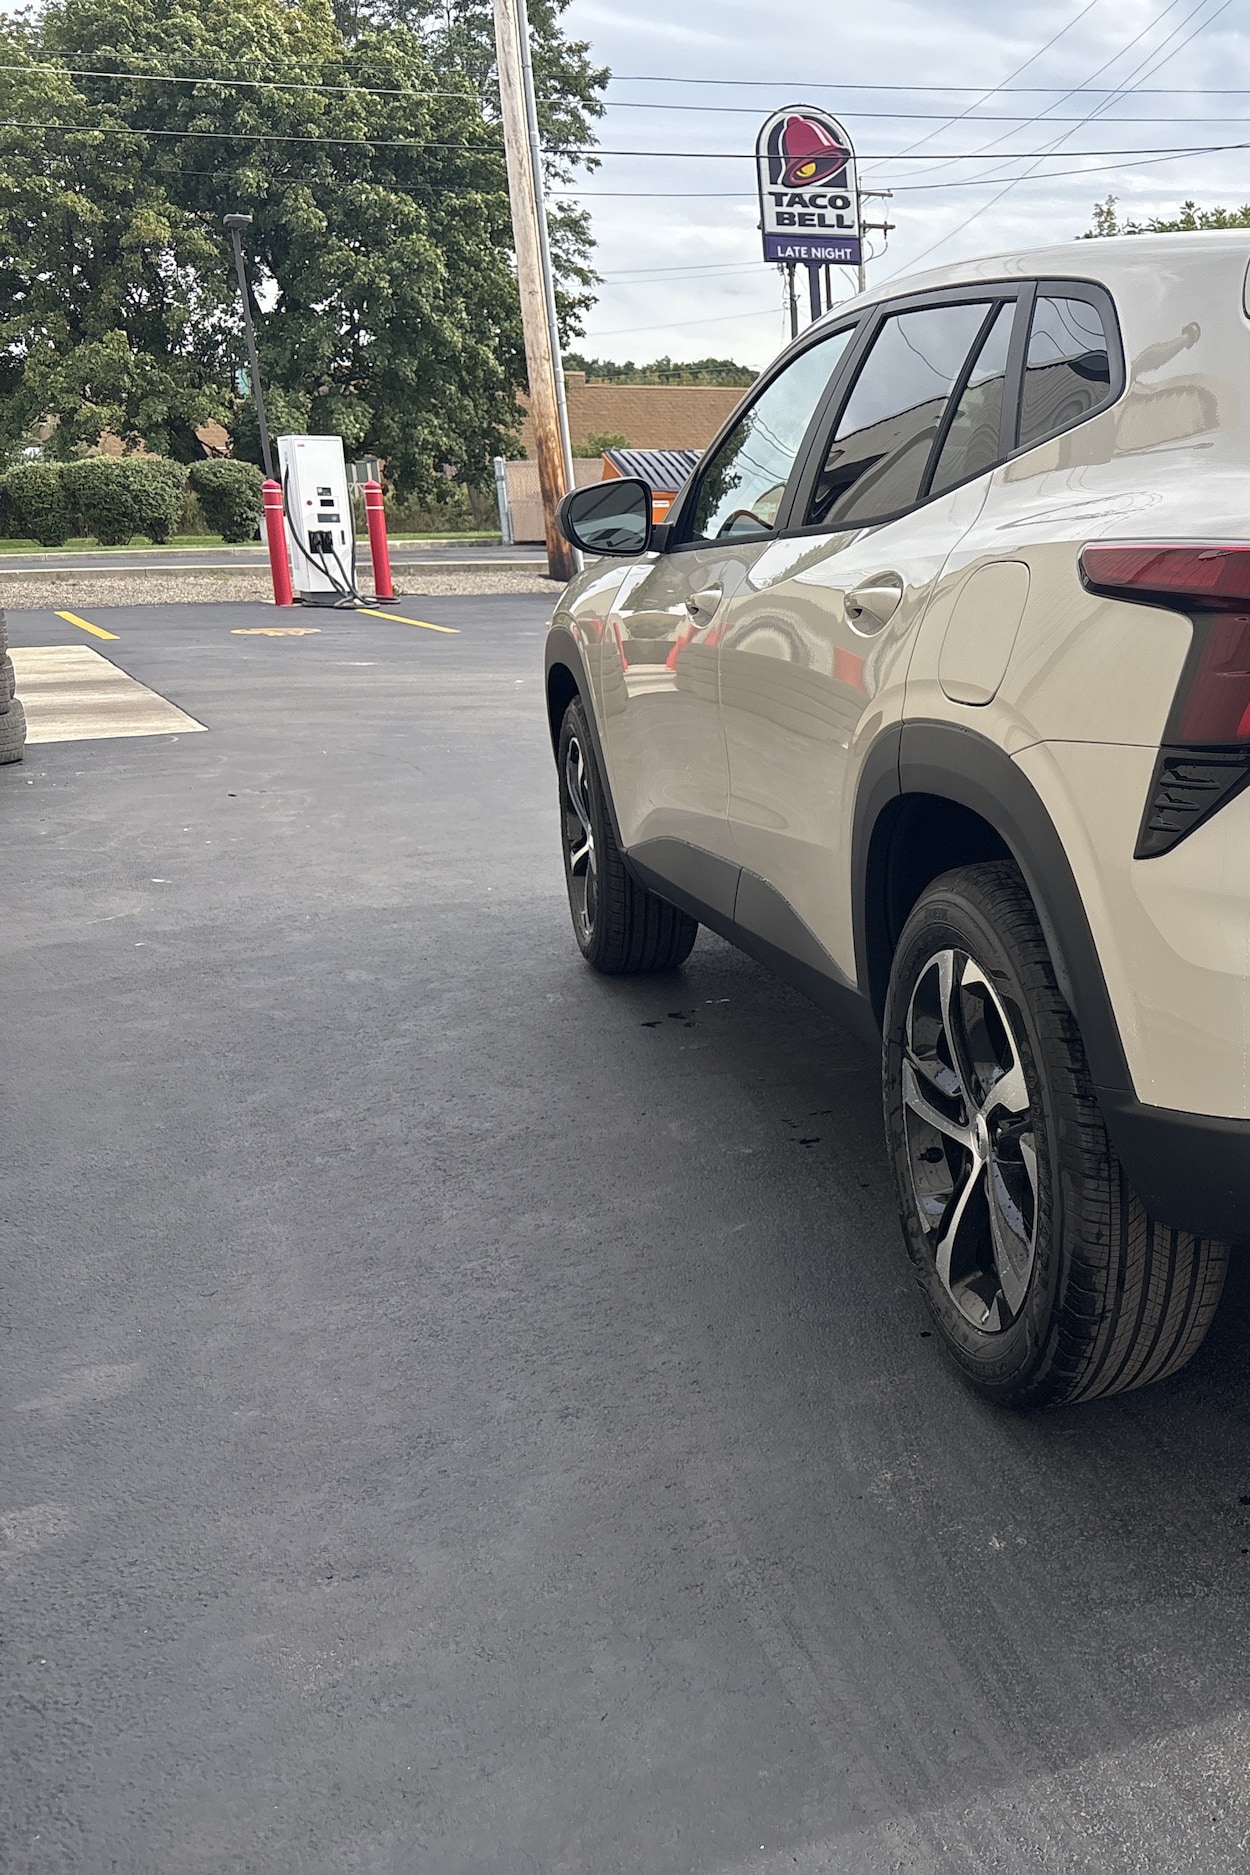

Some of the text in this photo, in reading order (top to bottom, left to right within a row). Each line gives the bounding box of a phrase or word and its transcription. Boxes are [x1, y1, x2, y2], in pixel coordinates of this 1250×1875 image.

[768, 191, 851, 210] TACO
[775, 211, 855, 229] BELL
[777, 245, 852, 260] LATE NIGHT
